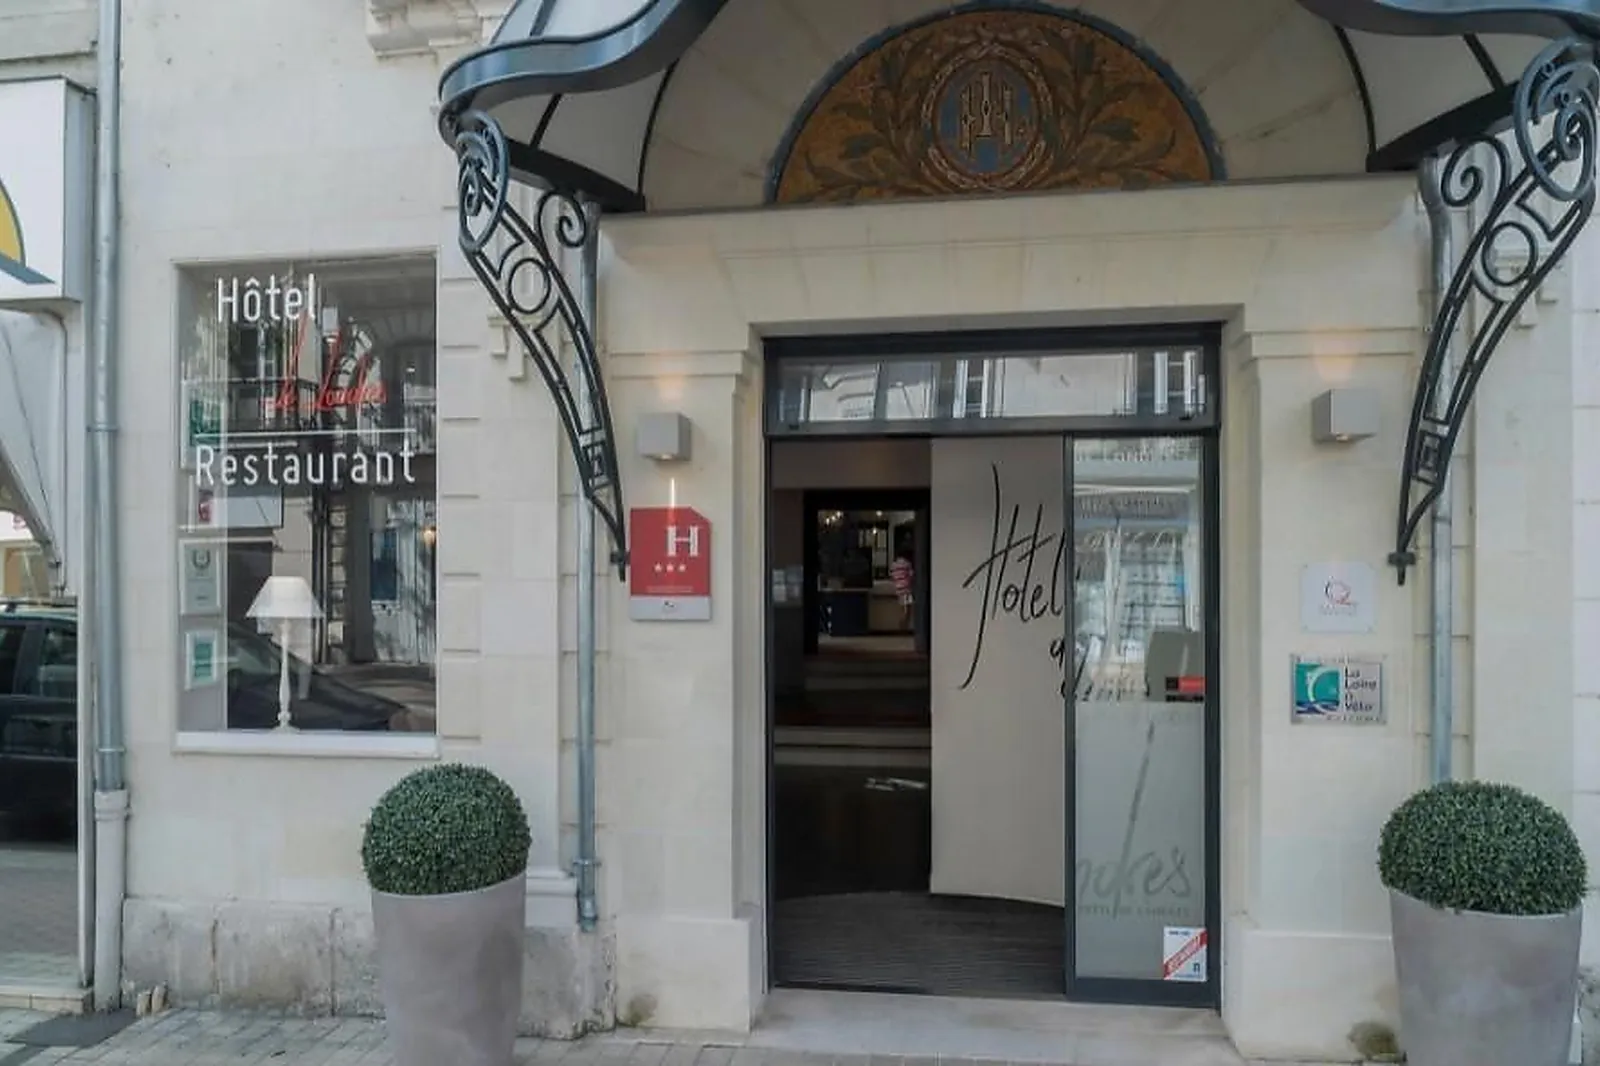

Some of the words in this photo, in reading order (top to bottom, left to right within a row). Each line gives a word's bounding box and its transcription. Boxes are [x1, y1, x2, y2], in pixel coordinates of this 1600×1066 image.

[217, 273, 316, 323] Hôtel
[195, 439, 416, 486] Restaurant
[667, 525, 699, 557] H
